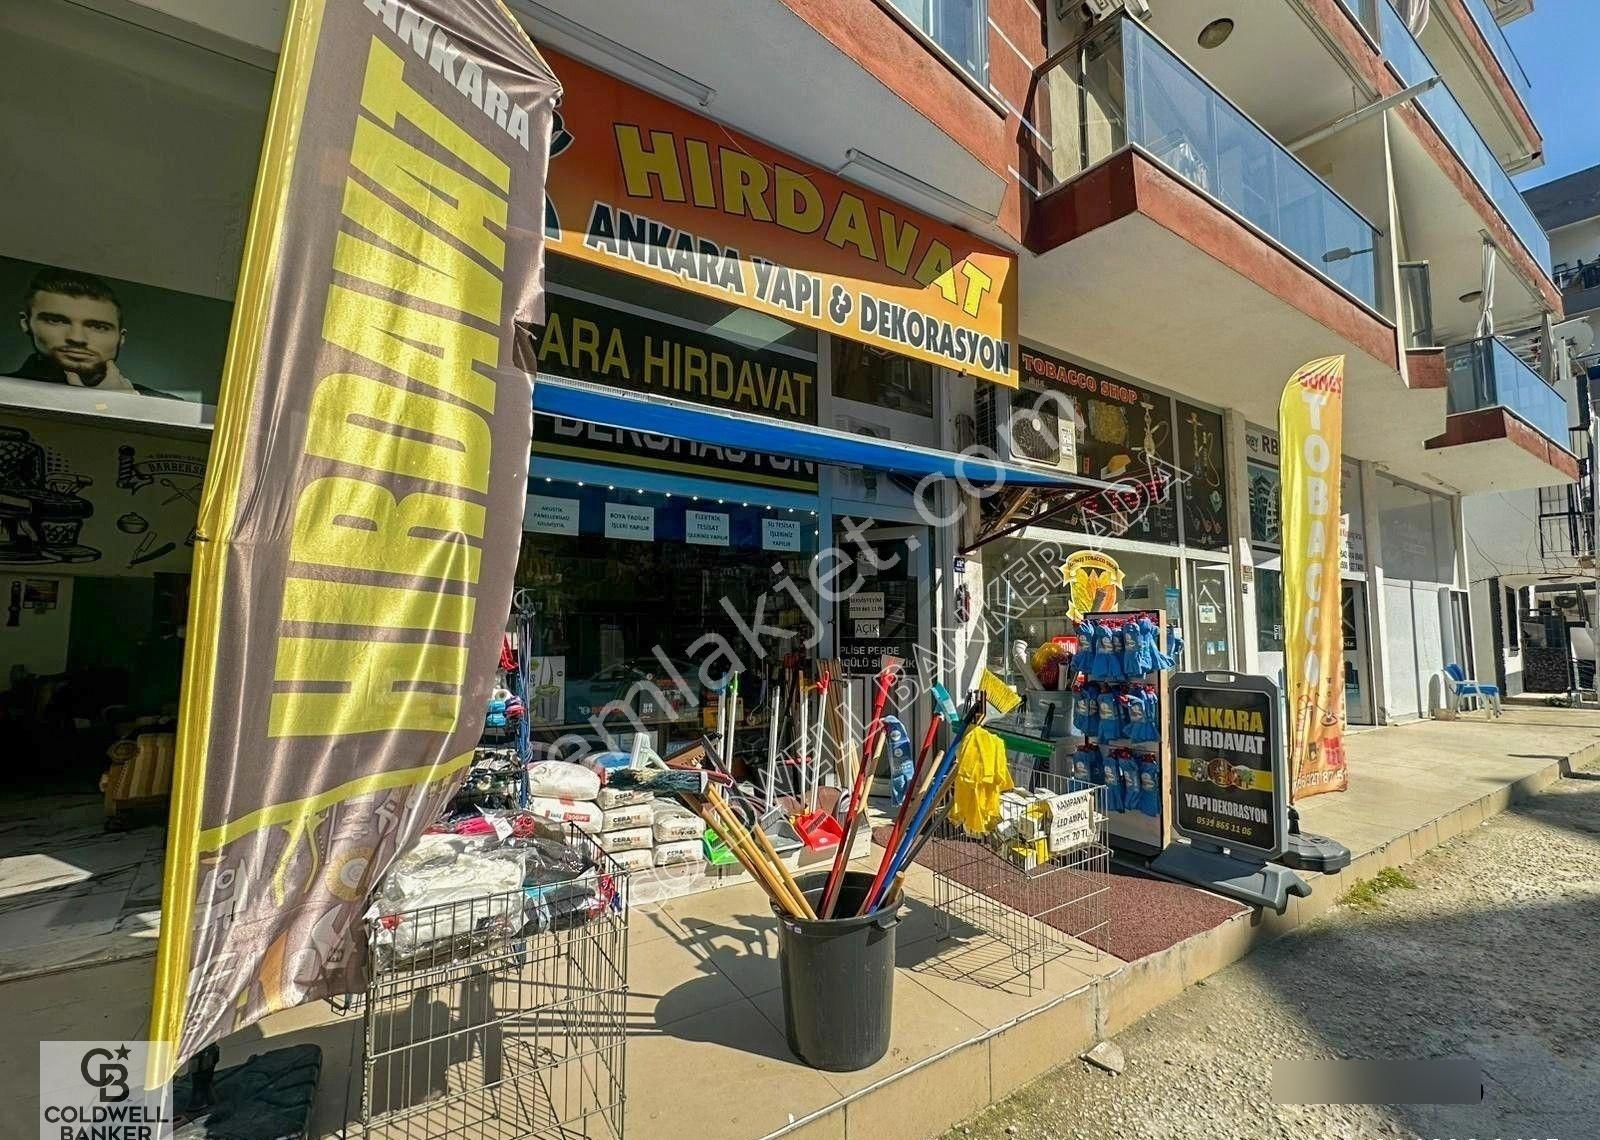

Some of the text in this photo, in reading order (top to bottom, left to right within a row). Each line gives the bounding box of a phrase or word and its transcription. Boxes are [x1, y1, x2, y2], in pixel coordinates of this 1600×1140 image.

[613, 122, 993, 319] HIRDAVAT
[582, 200, 1011, 377] ANKARA YAPI & DEKORASYON
[267, 34, 511, 738] HIRDAVAT
[643, 335, 813, 418] HIRDAVAT
[1020, 352, 1138, 405] TOBACCO SHOP
[855, 623, 878, 635] AÇIK
[867, 646, 900, 655] PERDE
[1184, 705, 1264, 733] ANKARA
[1184, 728, 1265, 755] HIRDAVAT
[1056, 793, 1088, 810] KAMPANYA
[1185, 793, 1268, 824] YAPI DEKORASYON
[1072, 831, 1081, 841] 20
